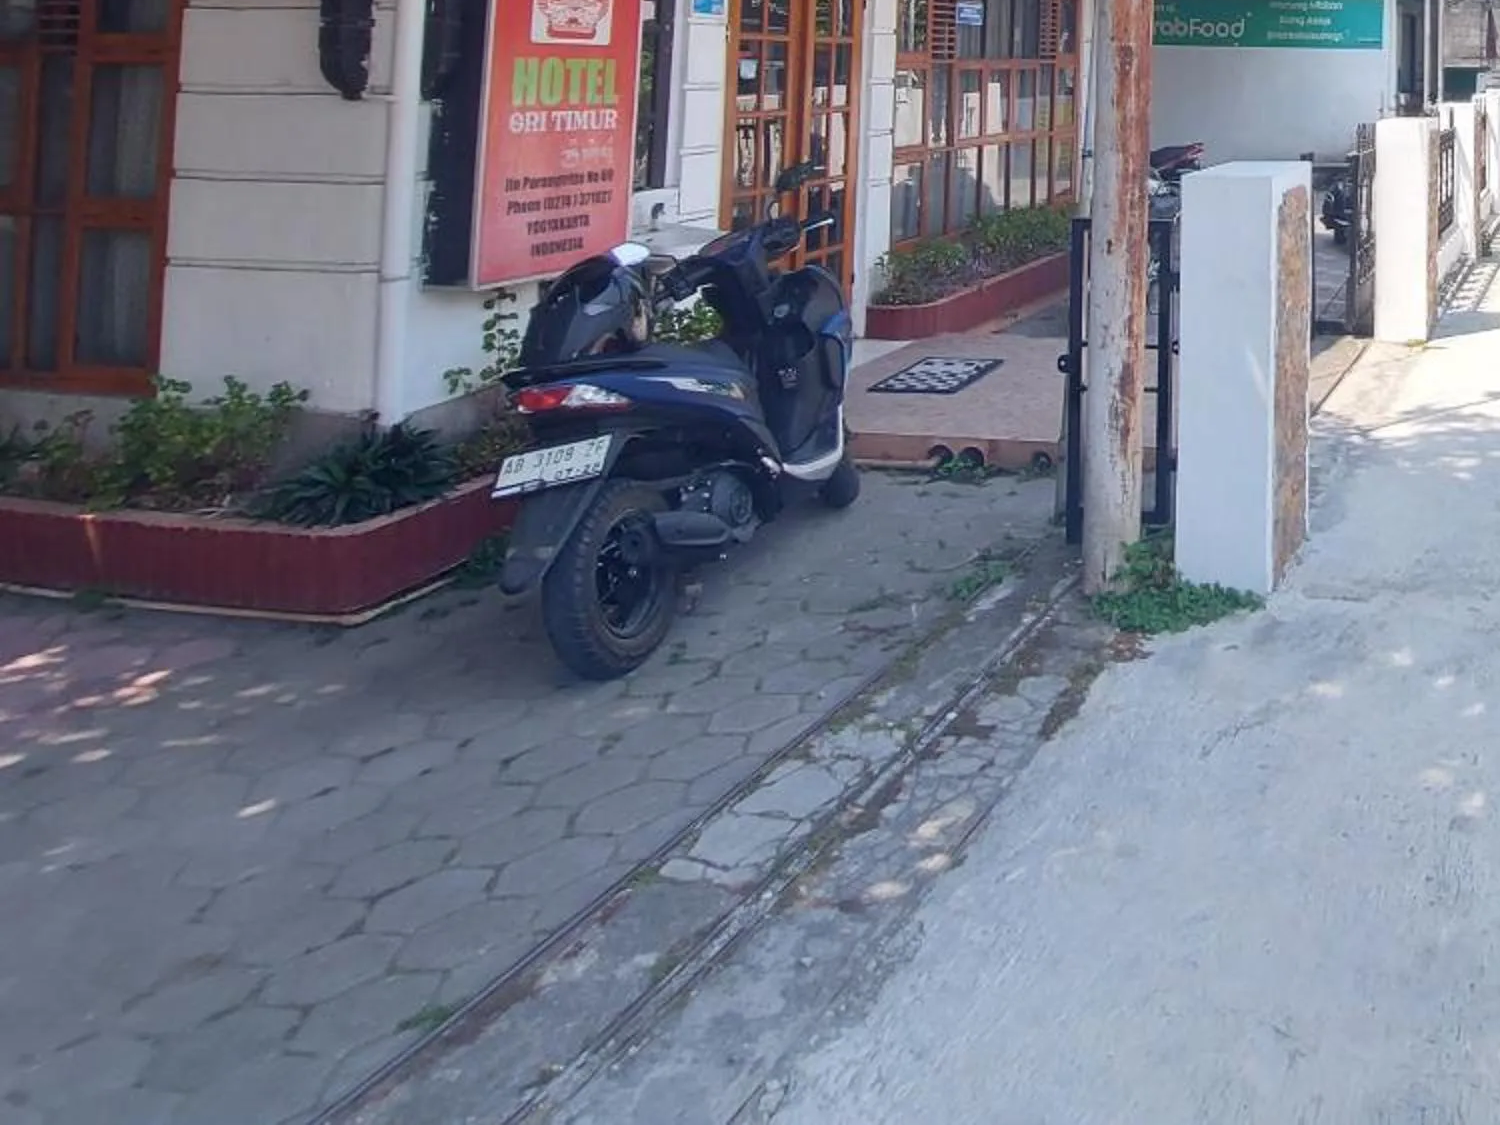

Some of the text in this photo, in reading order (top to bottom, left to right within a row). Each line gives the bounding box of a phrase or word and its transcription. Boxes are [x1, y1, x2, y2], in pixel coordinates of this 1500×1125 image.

[512, 57, 619, 107] HOTEL
[510, 108, 618, 133] SRI TIMUR
